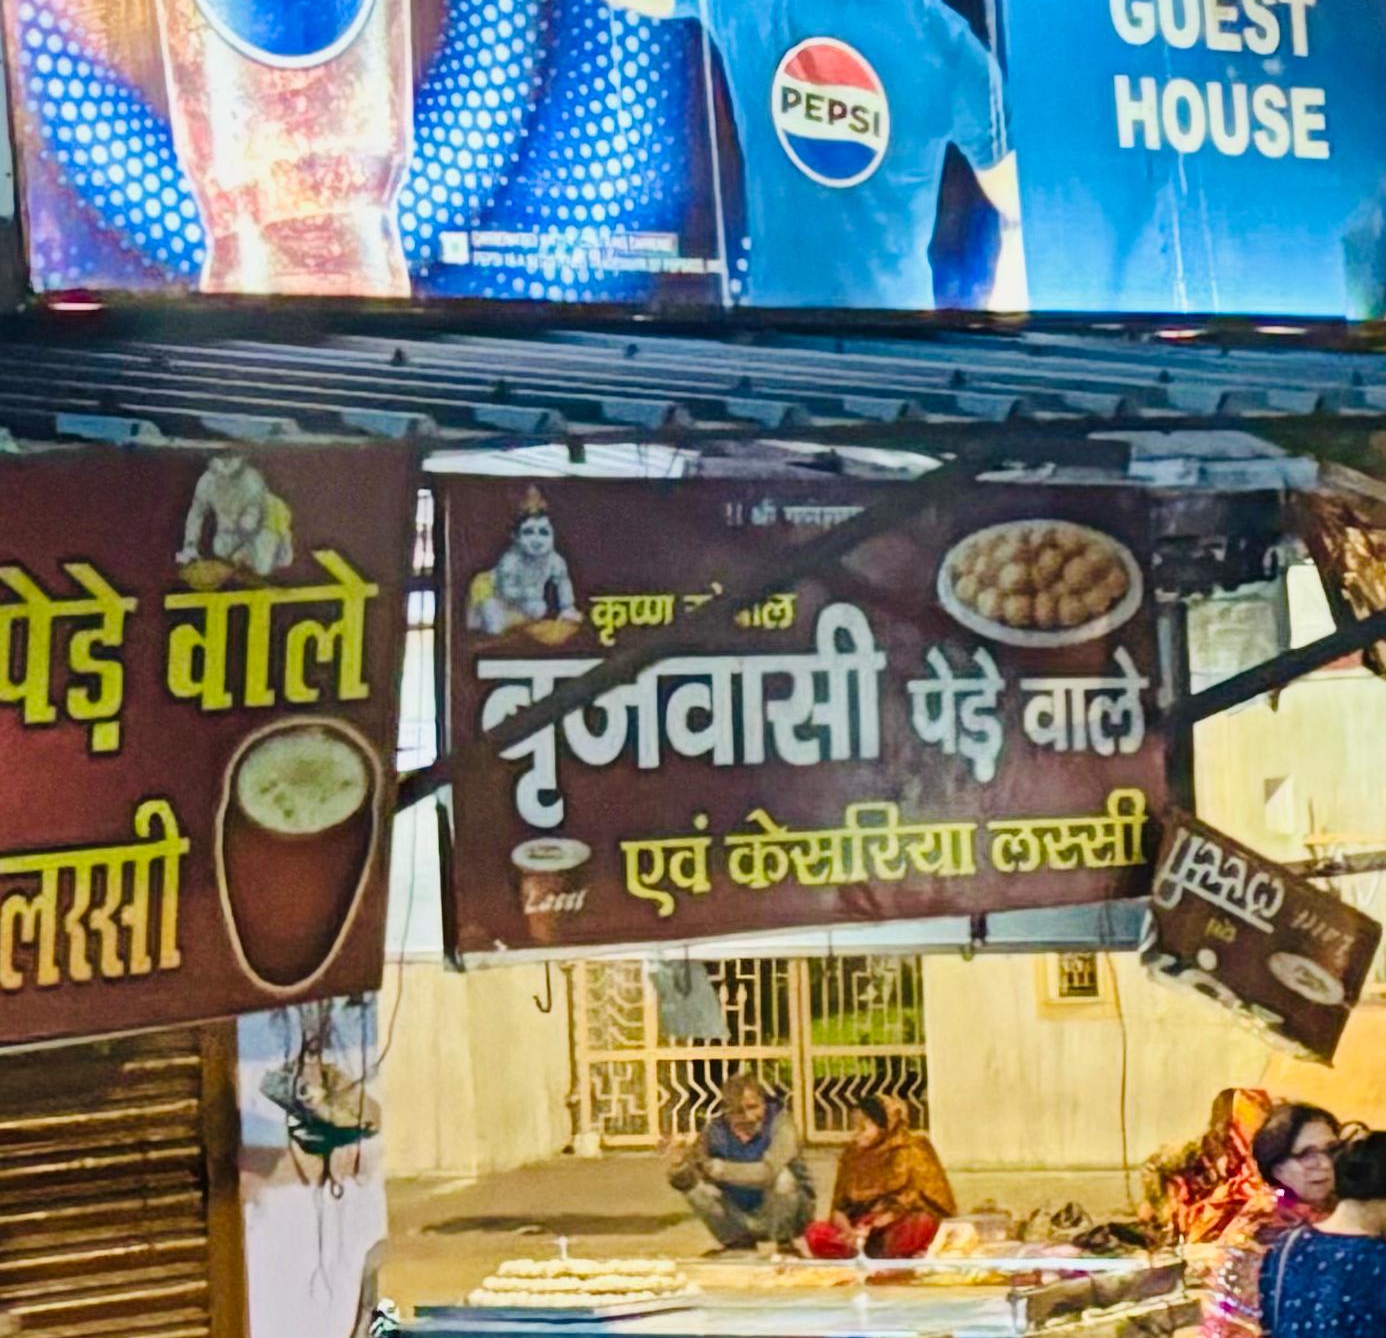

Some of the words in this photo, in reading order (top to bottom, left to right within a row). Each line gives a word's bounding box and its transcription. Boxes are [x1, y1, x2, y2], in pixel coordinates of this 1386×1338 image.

[780, 85, 882, 139] PEPSI
[1112, 73, 1331, 160] HOUSE
[0, 562, 139, 753] पेड़े
[163, 548, 380, 712] वाले
[589, 594, 677, 647] कृष्ण
[906, 645, 1007, 784] पेड़े
[1019, 644, 1147, 758] वाले
[619, 812, 713, 918] एवं
[723, 800, 979, 889] केसरिया
[986, 787, 1150, 874] लस्सी
[1152, 826, 1286, 935] लस्सी
